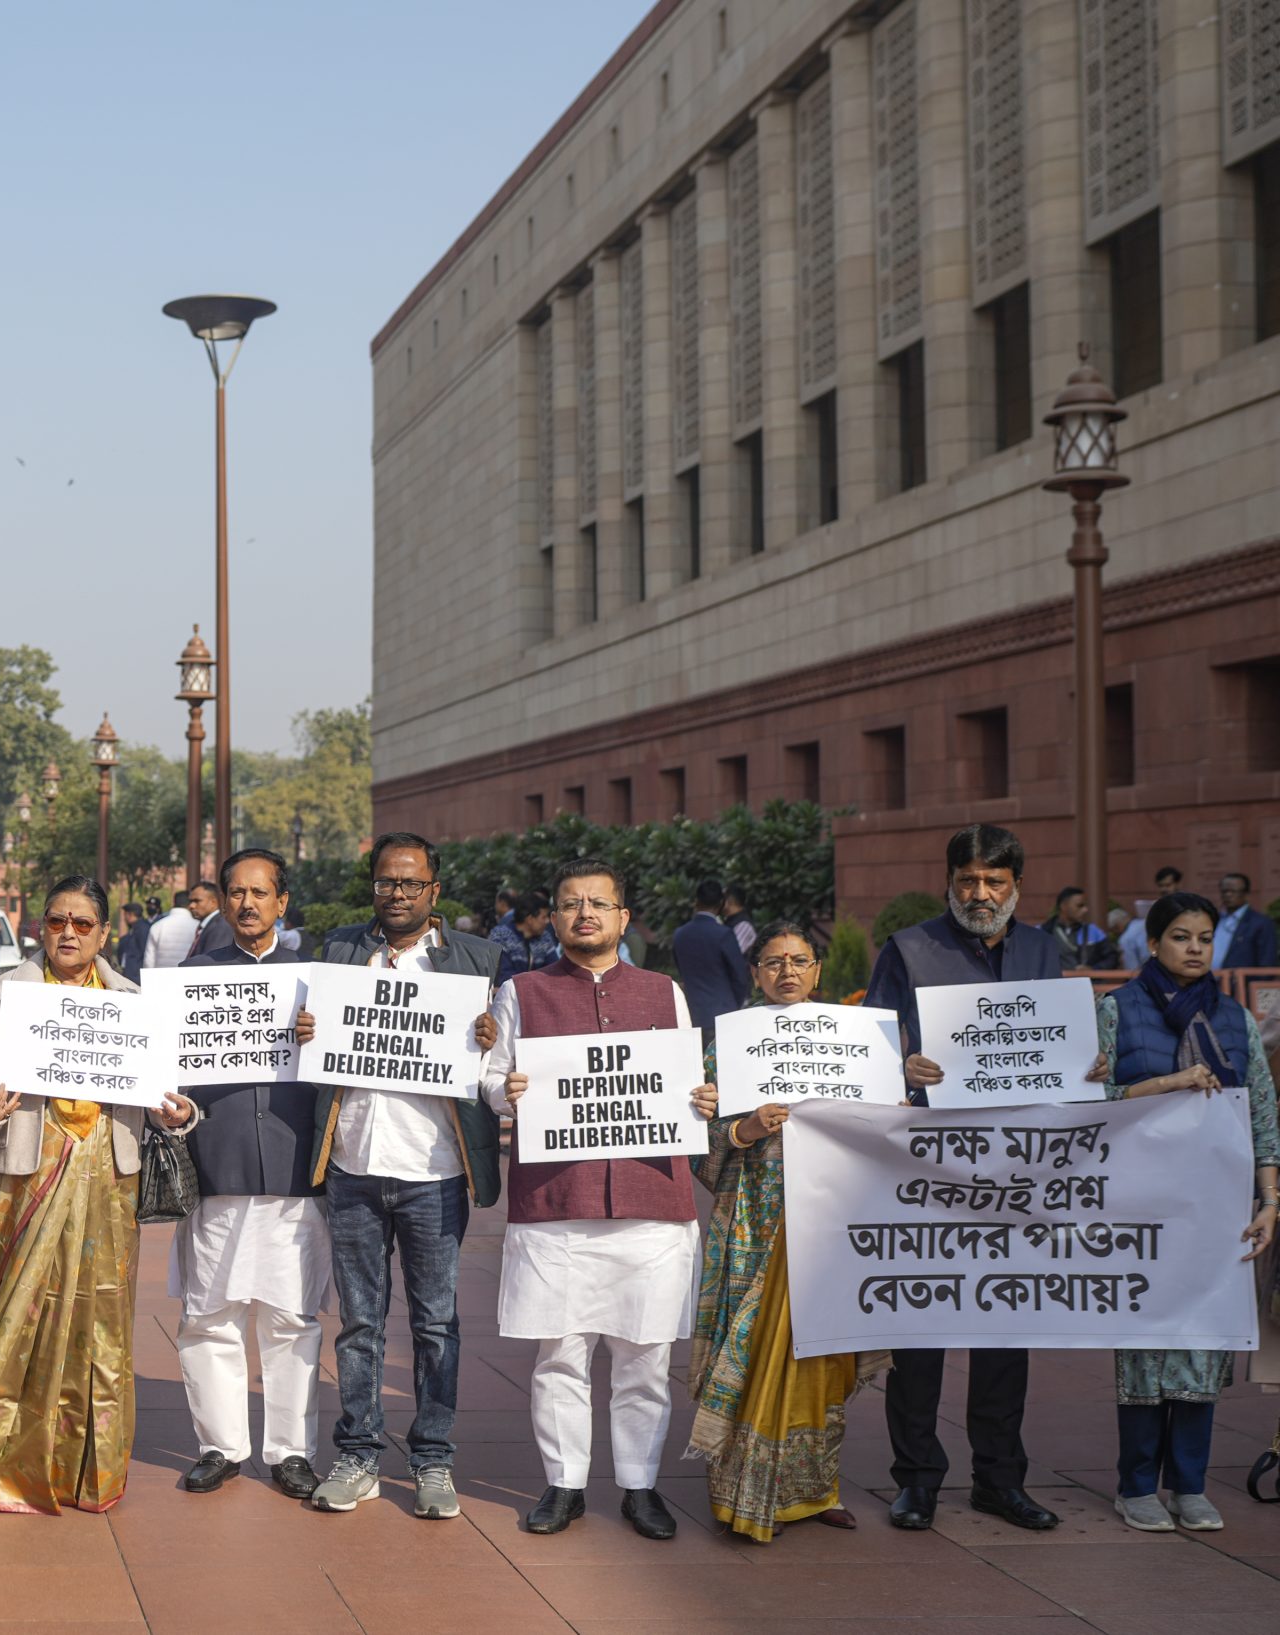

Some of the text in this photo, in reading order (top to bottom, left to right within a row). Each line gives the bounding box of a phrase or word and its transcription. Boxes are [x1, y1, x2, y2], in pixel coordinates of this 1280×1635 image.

[184, 982, 276, 1004] লক্ষ মানুষ,
[374, 979, 419, 1008] BJP
[60, 997, 122, 1023] বিজেপি
[185, 1004, 275, 1026] একটাই প্রশ্ন
[342, 1005, 445, 1035] DEPRIVING
[976, 995, 1037, 1020] বিজেপি
[29, 1019, 150, 1050] পরিকল্পিতভাবে
[241, 1028, 296, 1045] পাওনা
[774, 1014, 839, 1034] বিজেপি
[951, 1022, 1067, 1047] পরিকল্পিতভাবে
[53, 1047, 124, 1068] বাংলাকে
[352, 1031, 429, 1059] BENGAL.
[746, 1035, 870, 1058] পরিকল্পিতভাবে
[323, 1052, 453, 1085] DELIBERATELY.
[587, 1044, 631, 1074] BJP
[771, 1061, 846, 1076] বাংলাকে
[975, 1050, 1045, 1069] বাংলাকে
[35, 1062, 139, 1090] বঞ্চিত করছে
[557, 1072, 663, 1100] DEPRIVING
[757, 1076, 864, 1100] বঞ্চিত করছে
[962, 1070, 1064, 1093] বঞ্চিত করছে
[572, 1099, 651, 1124] BENGAL.
[544, 1122, 682, 1150] DELIBERATELY.
[908, 1121, 1110, 1170] লক্ষ মানুষ,
[896, 1173, 1109, 1216] একটাই প্রশ্ন
[847, 1222, 1164, 1261] আমাদের পাওনা
[858, 1274, 966, 1315] বেতন
